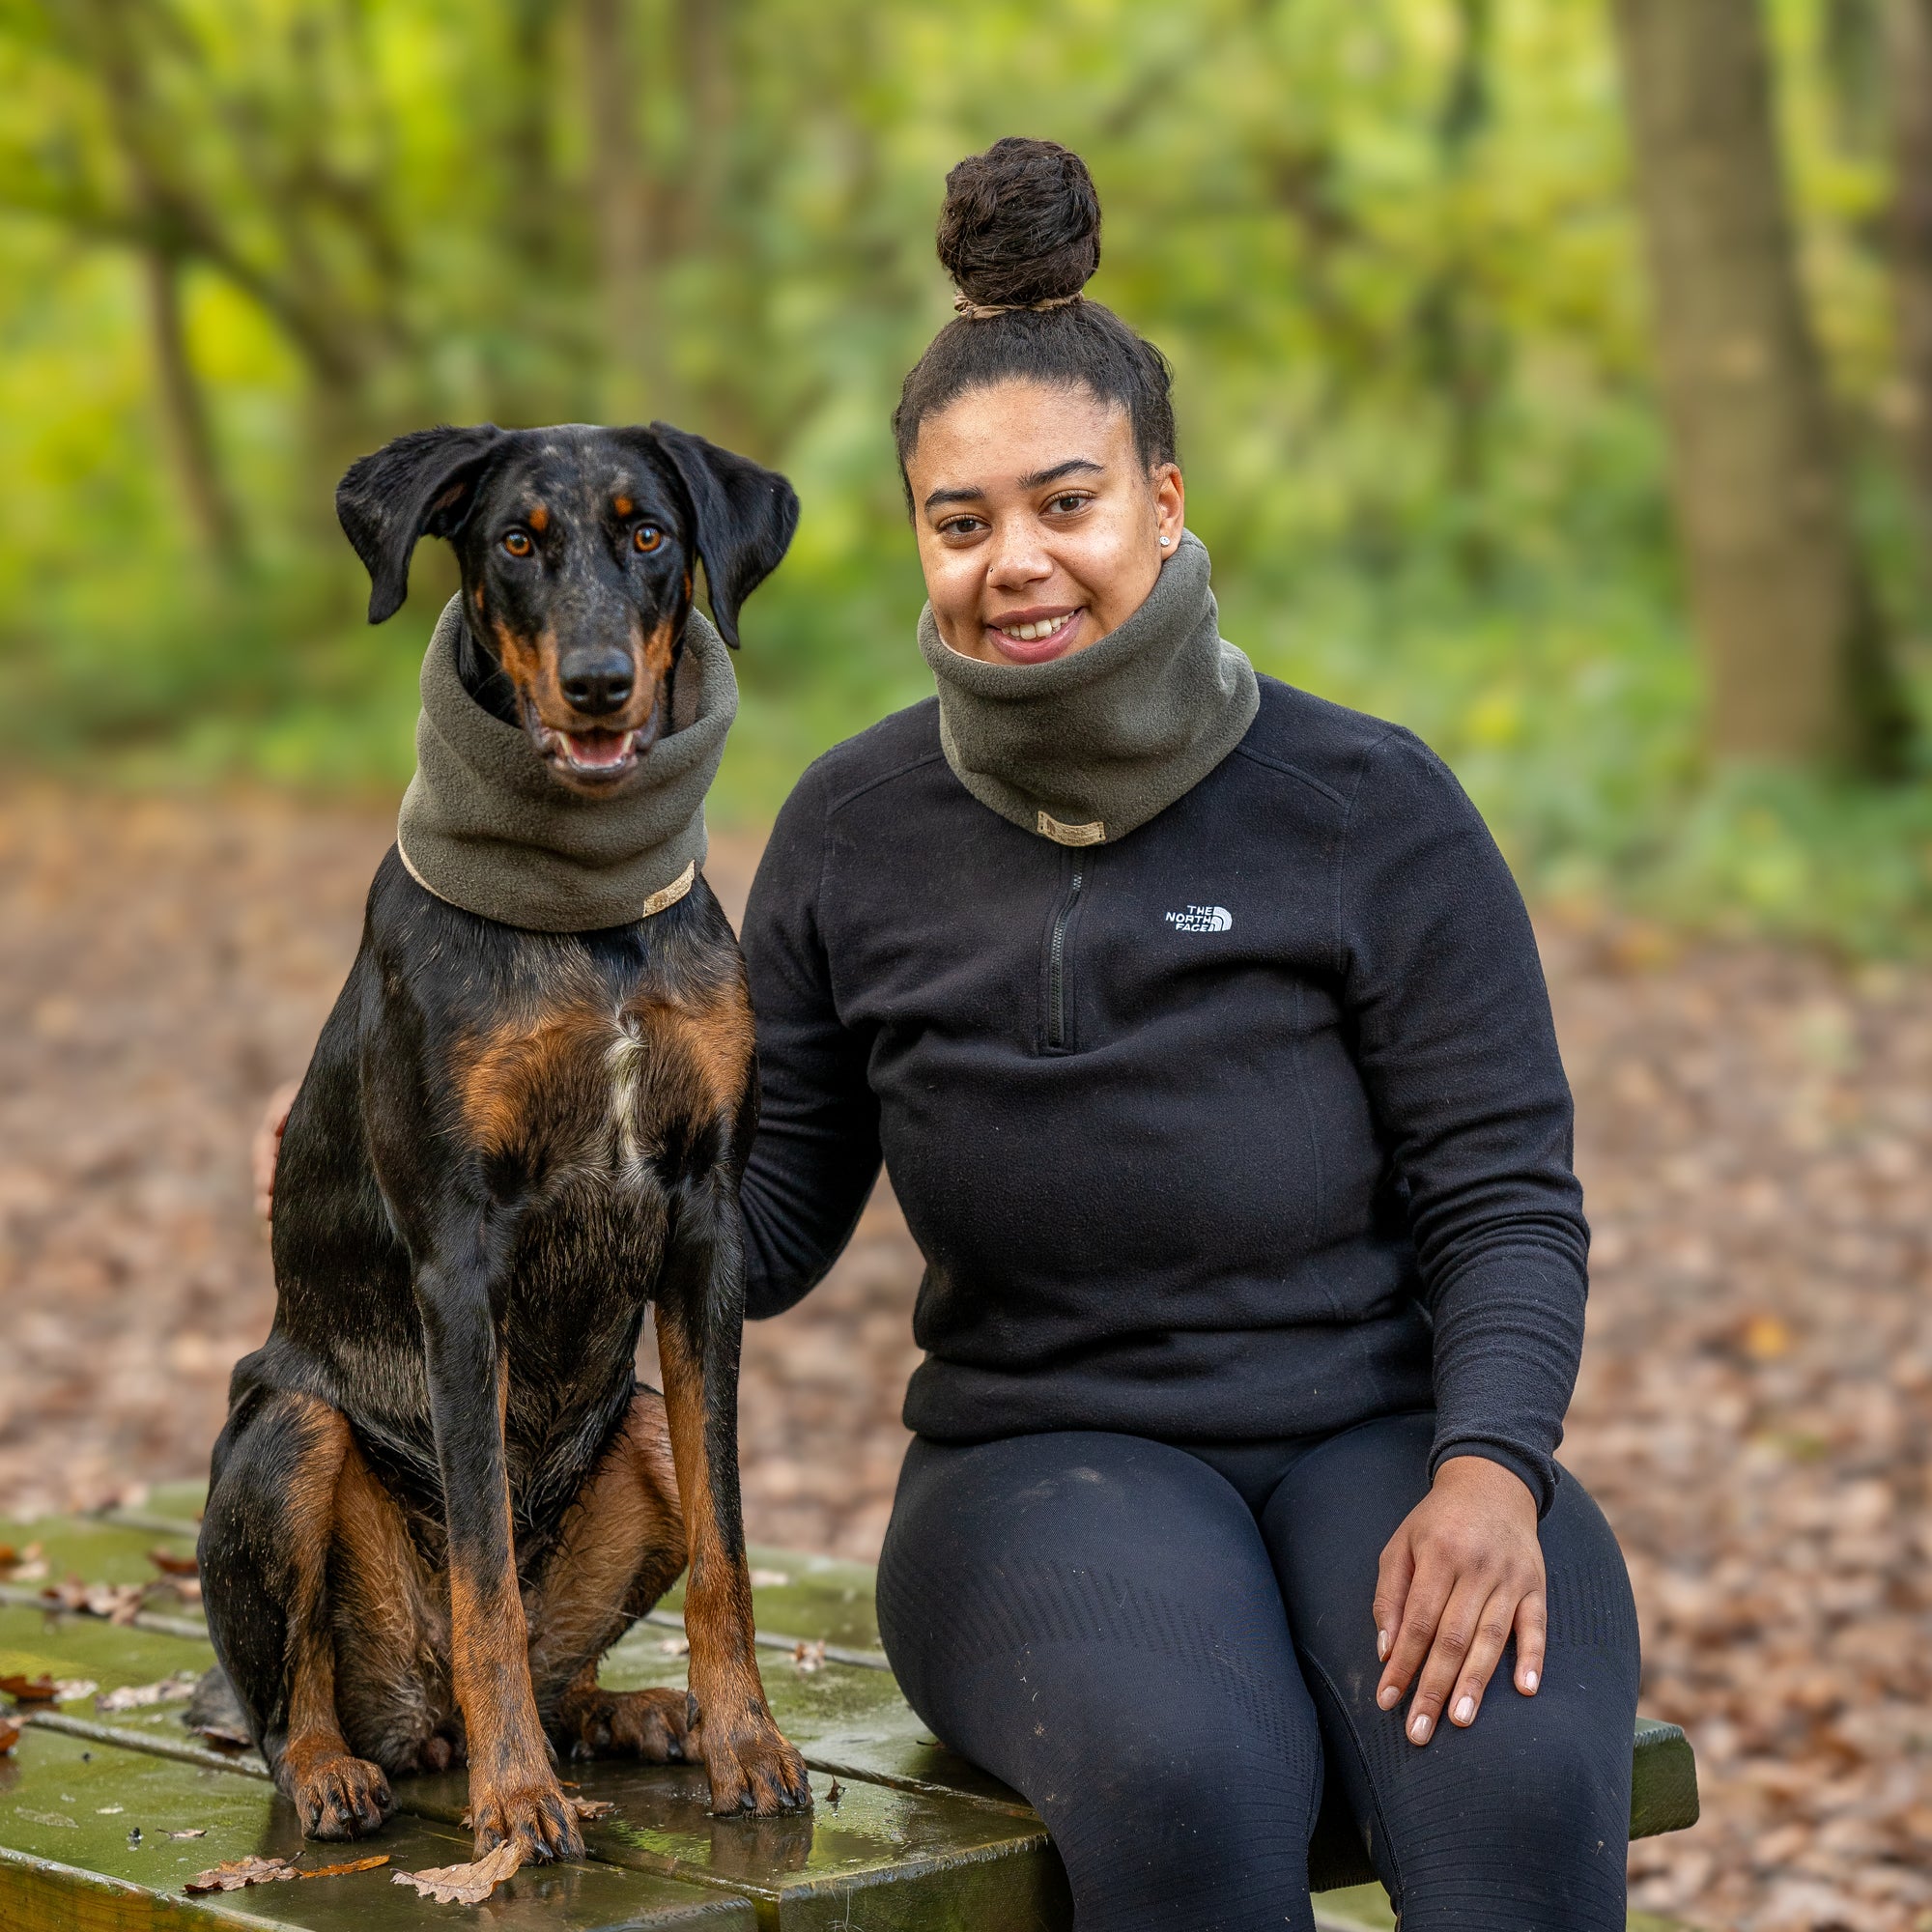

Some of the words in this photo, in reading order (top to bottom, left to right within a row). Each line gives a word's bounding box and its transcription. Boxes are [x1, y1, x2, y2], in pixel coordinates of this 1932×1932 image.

[1186, 905, 1213, 916] THE
[1165, 912, 1211, 924] NORTH
[1175, 923, 1208, 932] FACE
